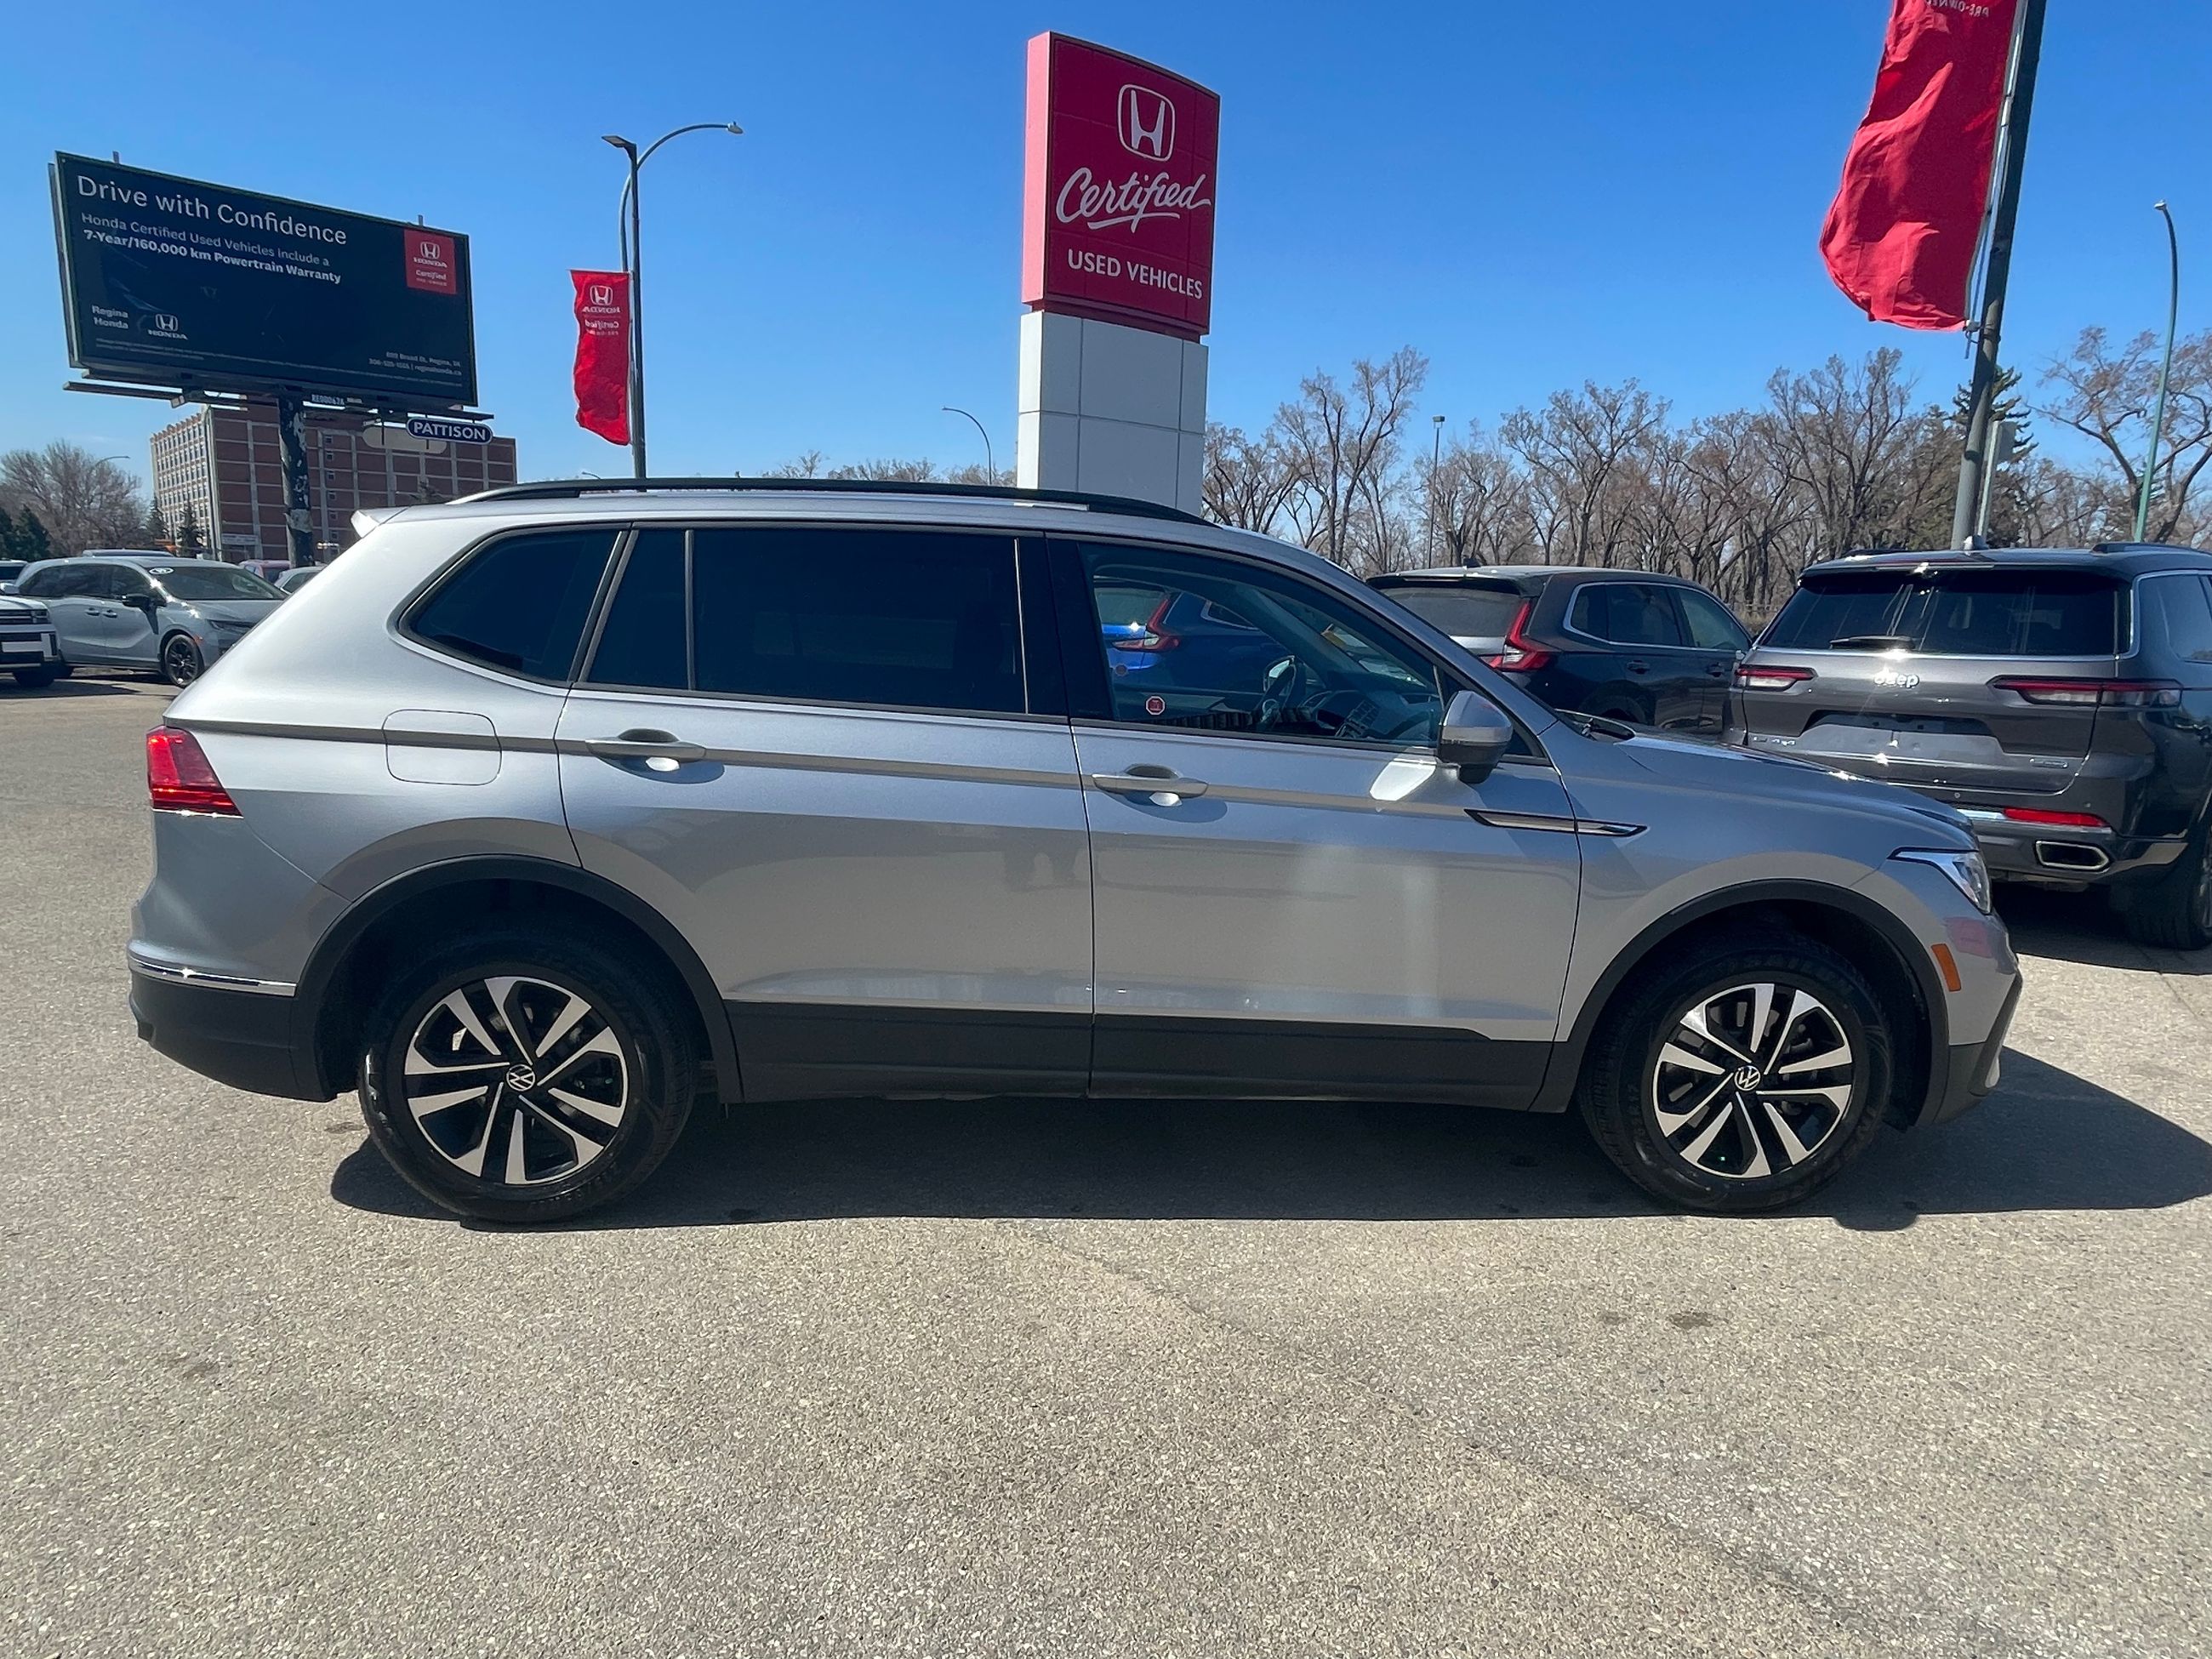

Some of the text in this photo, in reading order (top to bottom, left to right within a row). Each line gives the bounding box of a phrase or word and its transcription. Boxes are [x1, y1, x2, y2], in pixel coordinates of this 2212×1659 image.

[77, 175, 347, 245] Drive with Confidence
[1056, 167, 1211, 234] Certified
[81, 212, 127, 231] Honda
[130, 221, 186, 242] Certified
[190, 232, 221, 248] Used
[224, 238, 275, 257] Vehicles
[322, 258, 330, 266] a
[83, 229, 341, 285] 7-Year/160,000 km Powertrain Warranty
[1068, 248, 1203, 299] USED VEHICLES
[91, 305, 128, 318] Regina
[93, 316, 129, 329] Honda
[147, 329, 188, 340] HONDA
[413, 421, 486, 441] PATTISON
